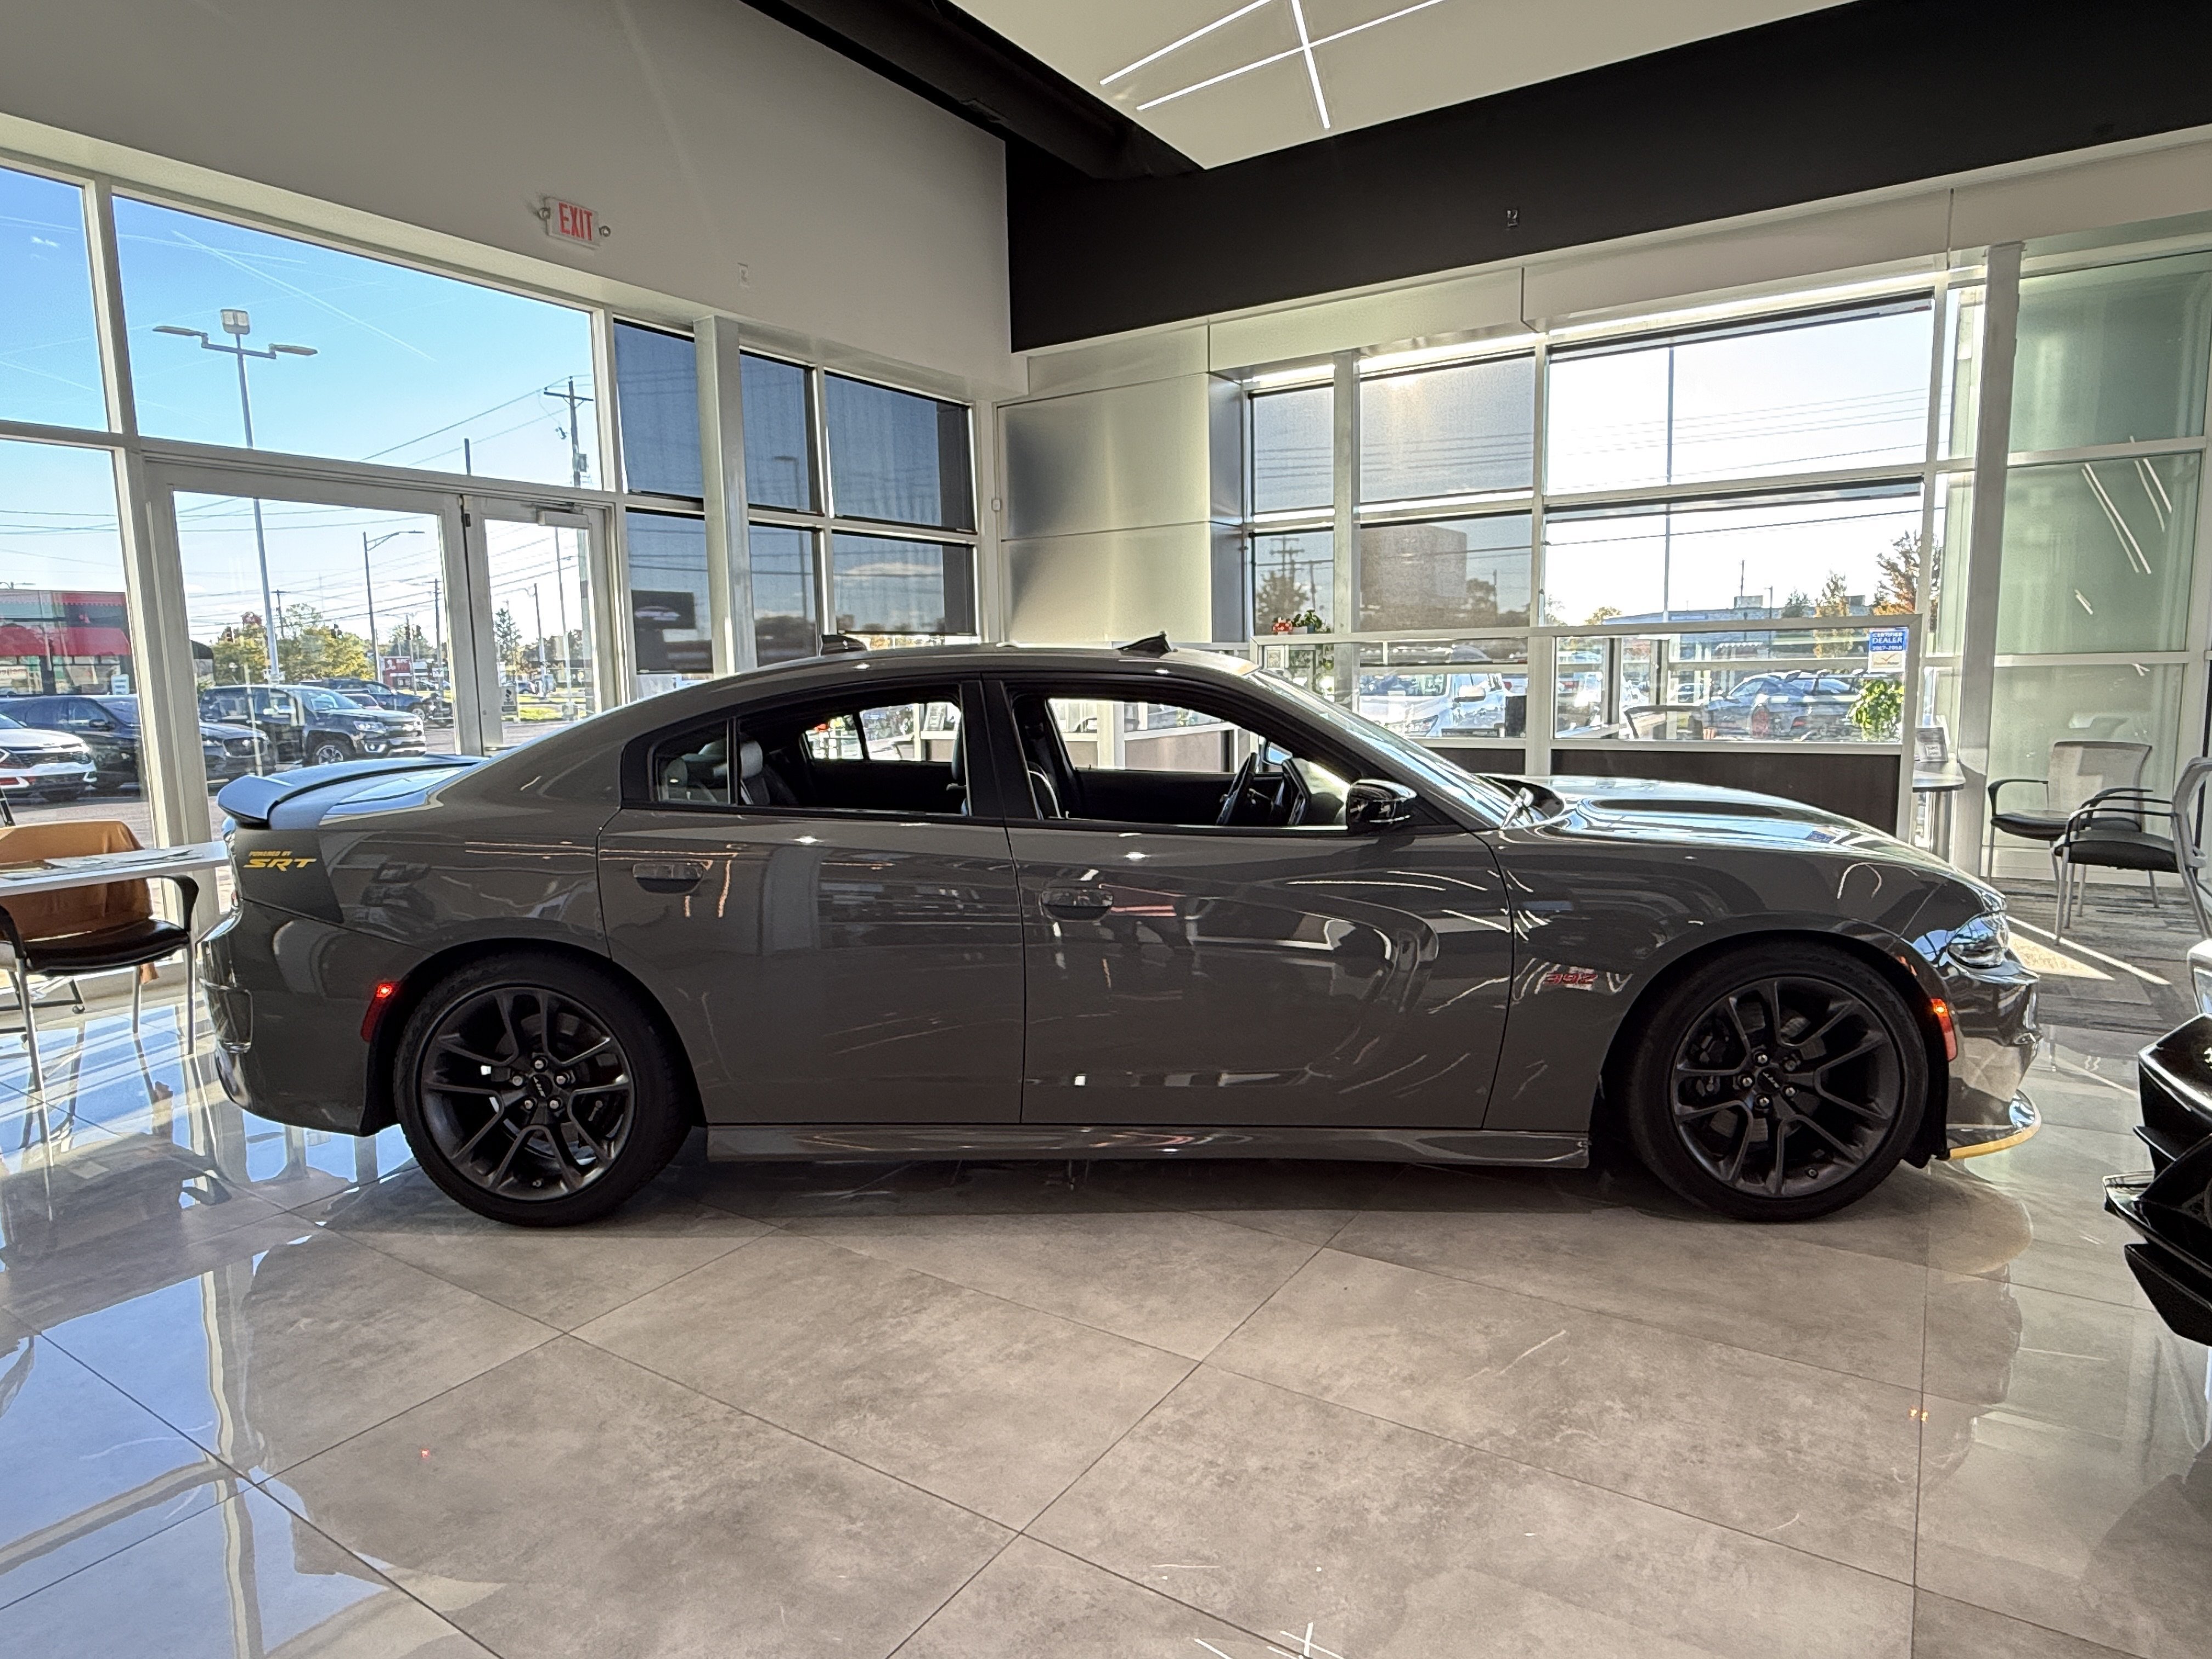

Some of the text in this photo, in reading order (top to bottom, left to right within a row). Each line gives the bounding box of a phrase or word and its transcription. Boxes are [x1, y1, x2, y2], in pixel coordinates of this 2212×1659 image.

[558, 201, 593, 241] EXIT
[242, 858, 317, 871] SRT
[1543, 972, 1599, 985] 392
